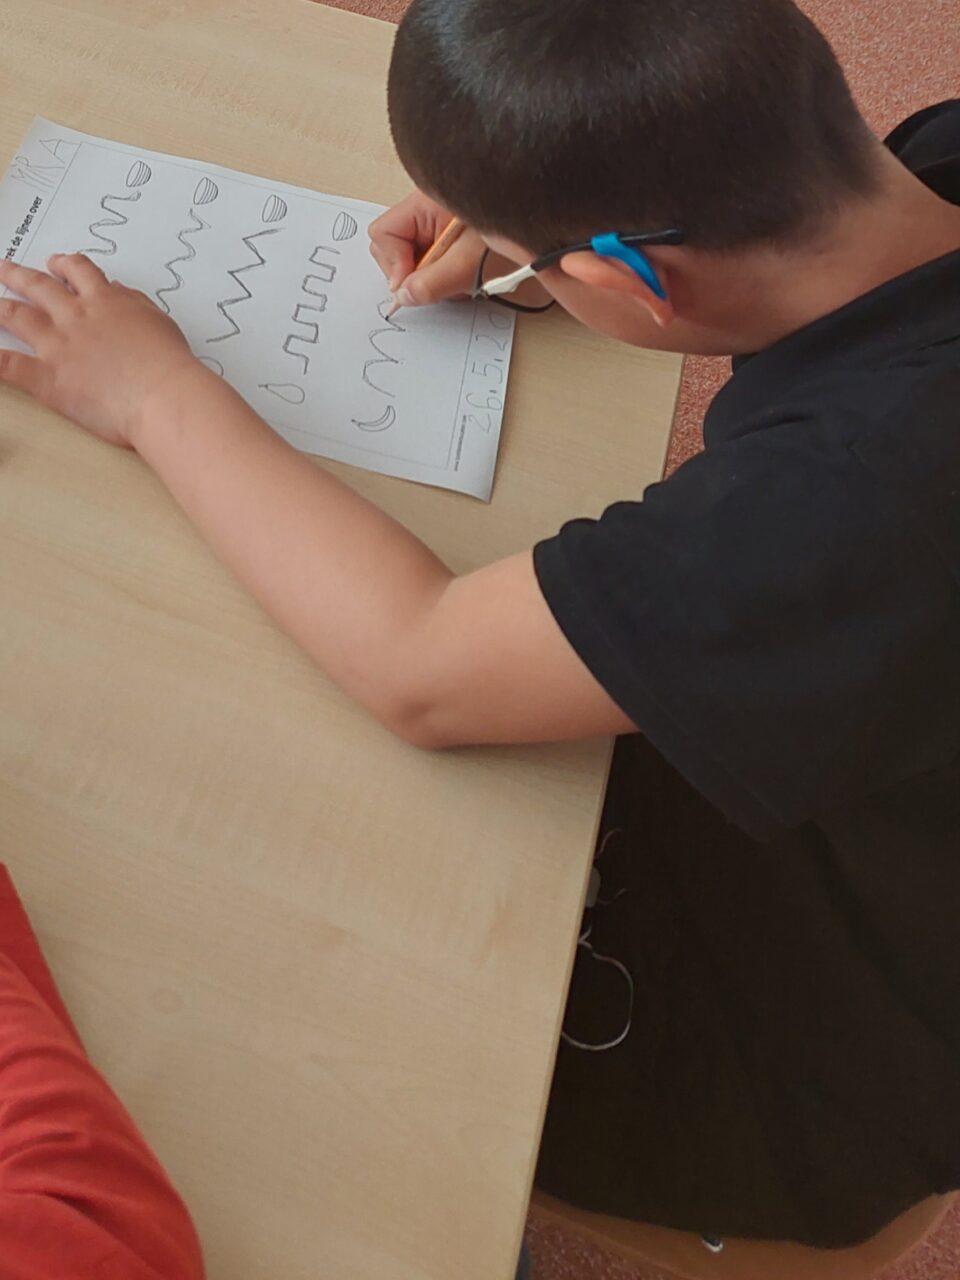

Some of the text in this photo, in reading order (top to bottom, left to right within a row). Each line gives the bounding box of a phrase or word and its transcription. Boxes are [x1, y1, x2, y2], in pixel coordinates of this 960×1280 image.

[4, 195, 43, 261] rek de lijnen over
